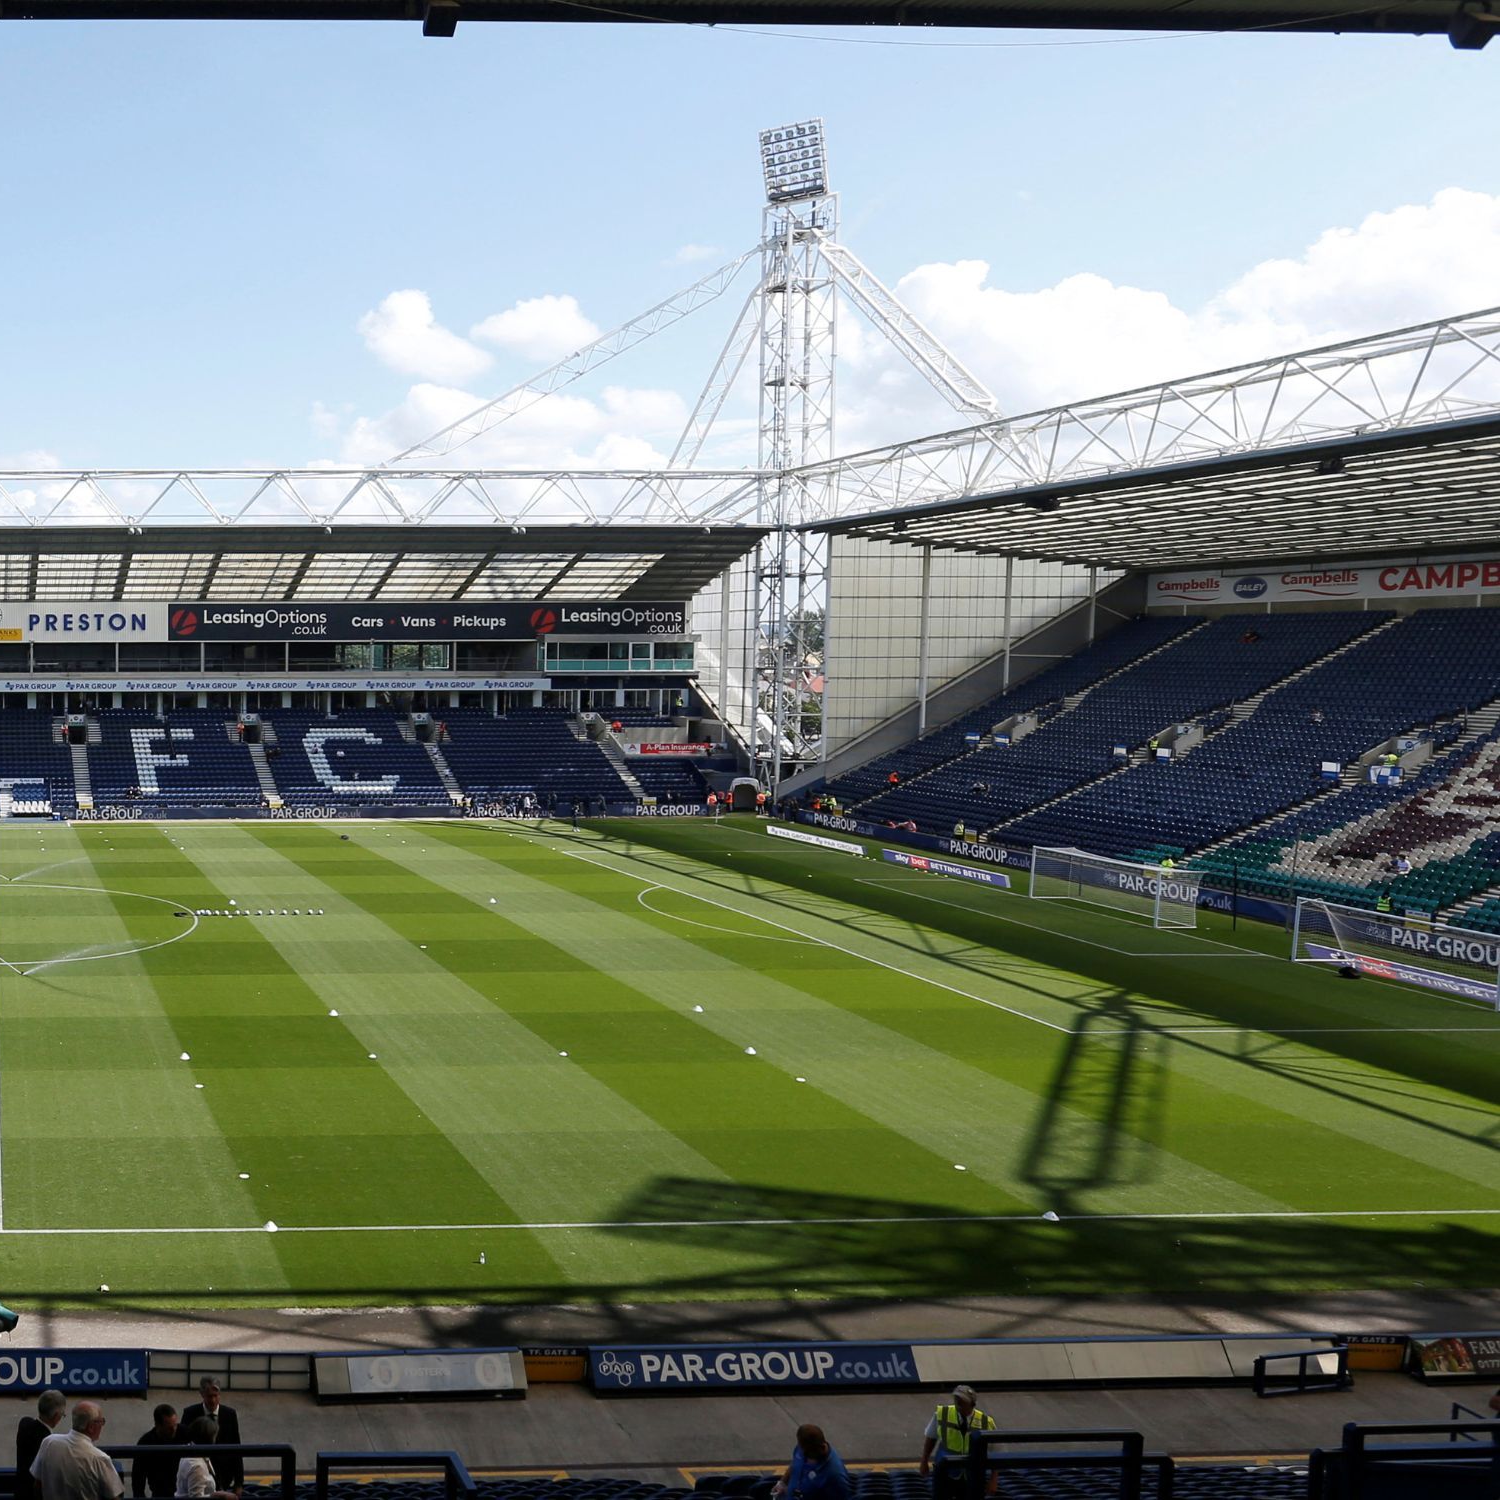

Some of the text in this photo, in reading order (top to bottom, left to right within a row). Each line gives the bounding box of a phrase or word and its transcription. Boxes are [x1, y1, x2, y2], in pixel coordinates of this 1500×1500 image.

[1156, 577, 1220, 592] Campbells
[1281, 570, 1359, 586] Campbells
[1378, 562, 1500, 591] CAMPB
[1235, 583, 1265, 593] BAILEY
[28, 613, 147, 631] PRESTON
[203, 609, 327, 628] LeasingOptions
[352, 615, 507, 630] Cars Vans Pickups
[561, 608, 682, 626] LeasingOptions
[291, 624, 327, 635] .co.uk
[894, 854, 992, 882] sky bet BETTING BETTER
[1362, 1336, 1387, 1344] GATE
[640, 1351, 912, 1383] PAR-GROUP.co.uk
